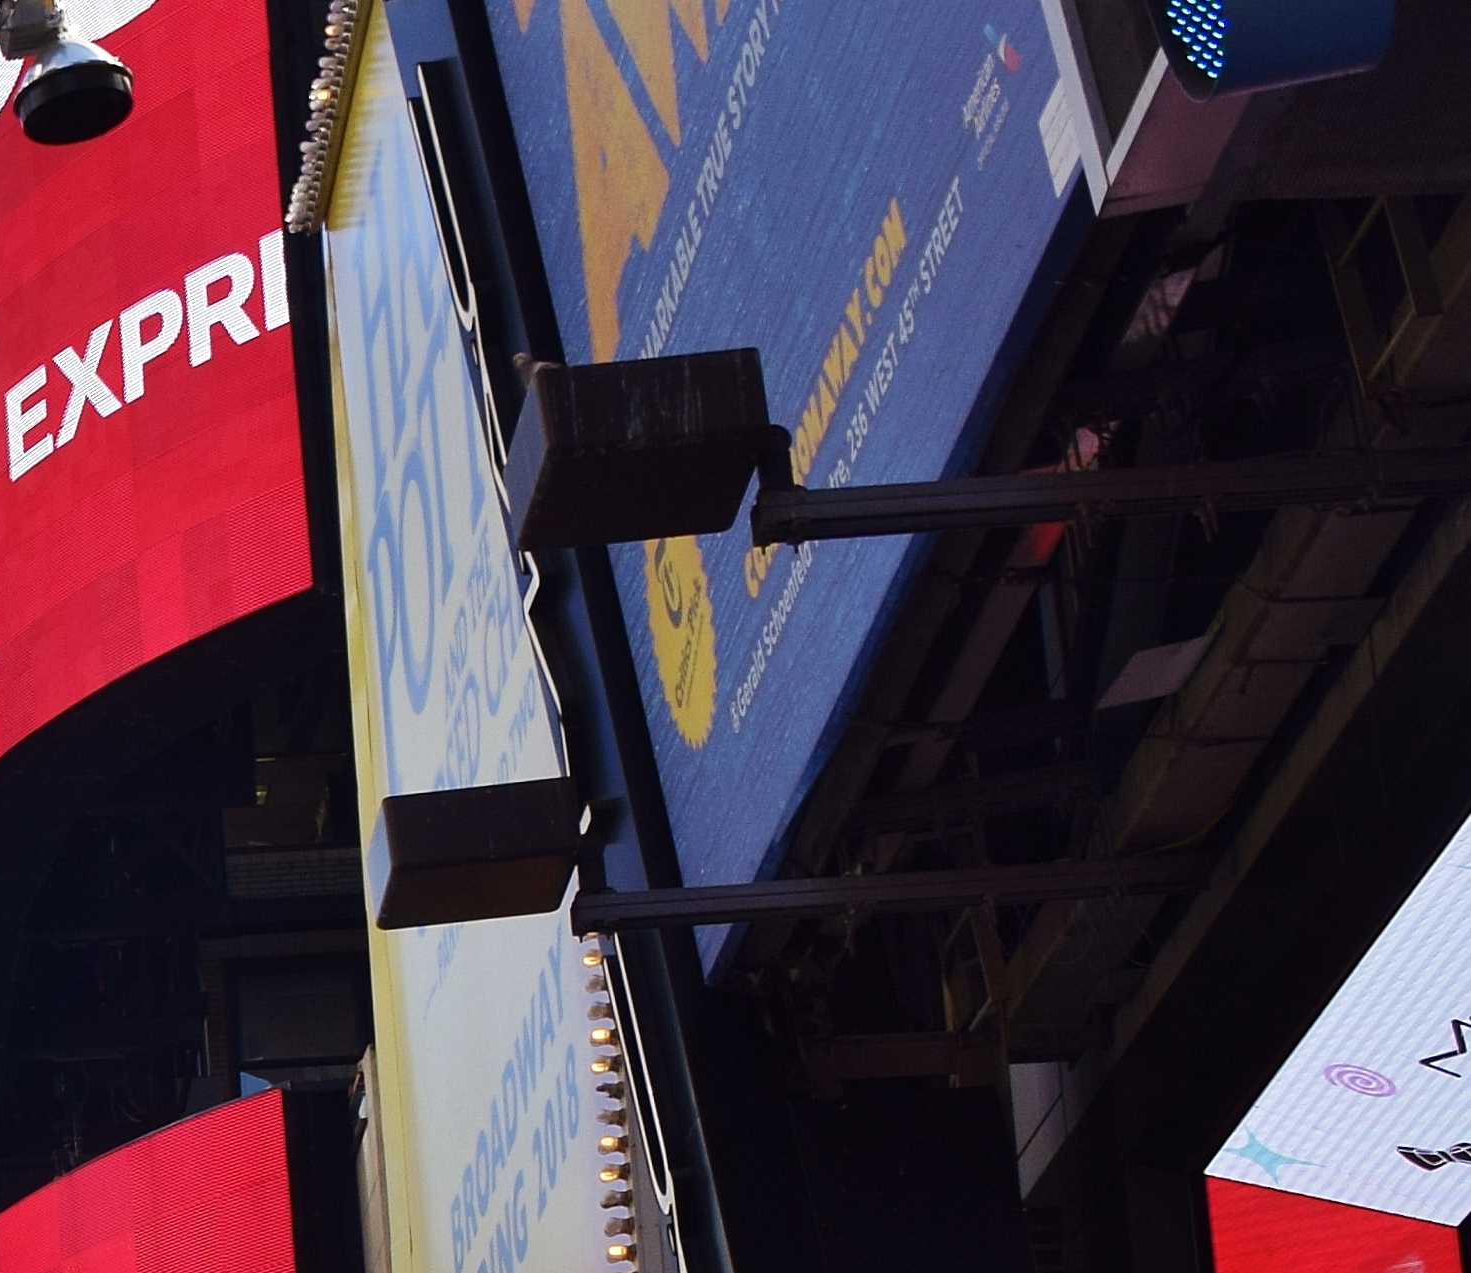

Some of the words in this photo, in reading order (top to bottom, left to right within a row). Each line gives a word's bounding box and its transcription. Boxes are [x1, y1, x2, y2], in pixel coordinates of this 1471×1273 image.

[697, 118, 735, 219] TRUE
[732, 22, 775, 135] STORY
[844, 411, 872, 452] 236
[862, 337, 901, 409] WEST
[918, 174, 967, 296] STREET
[532, 1042, 582, 1224] 2018
